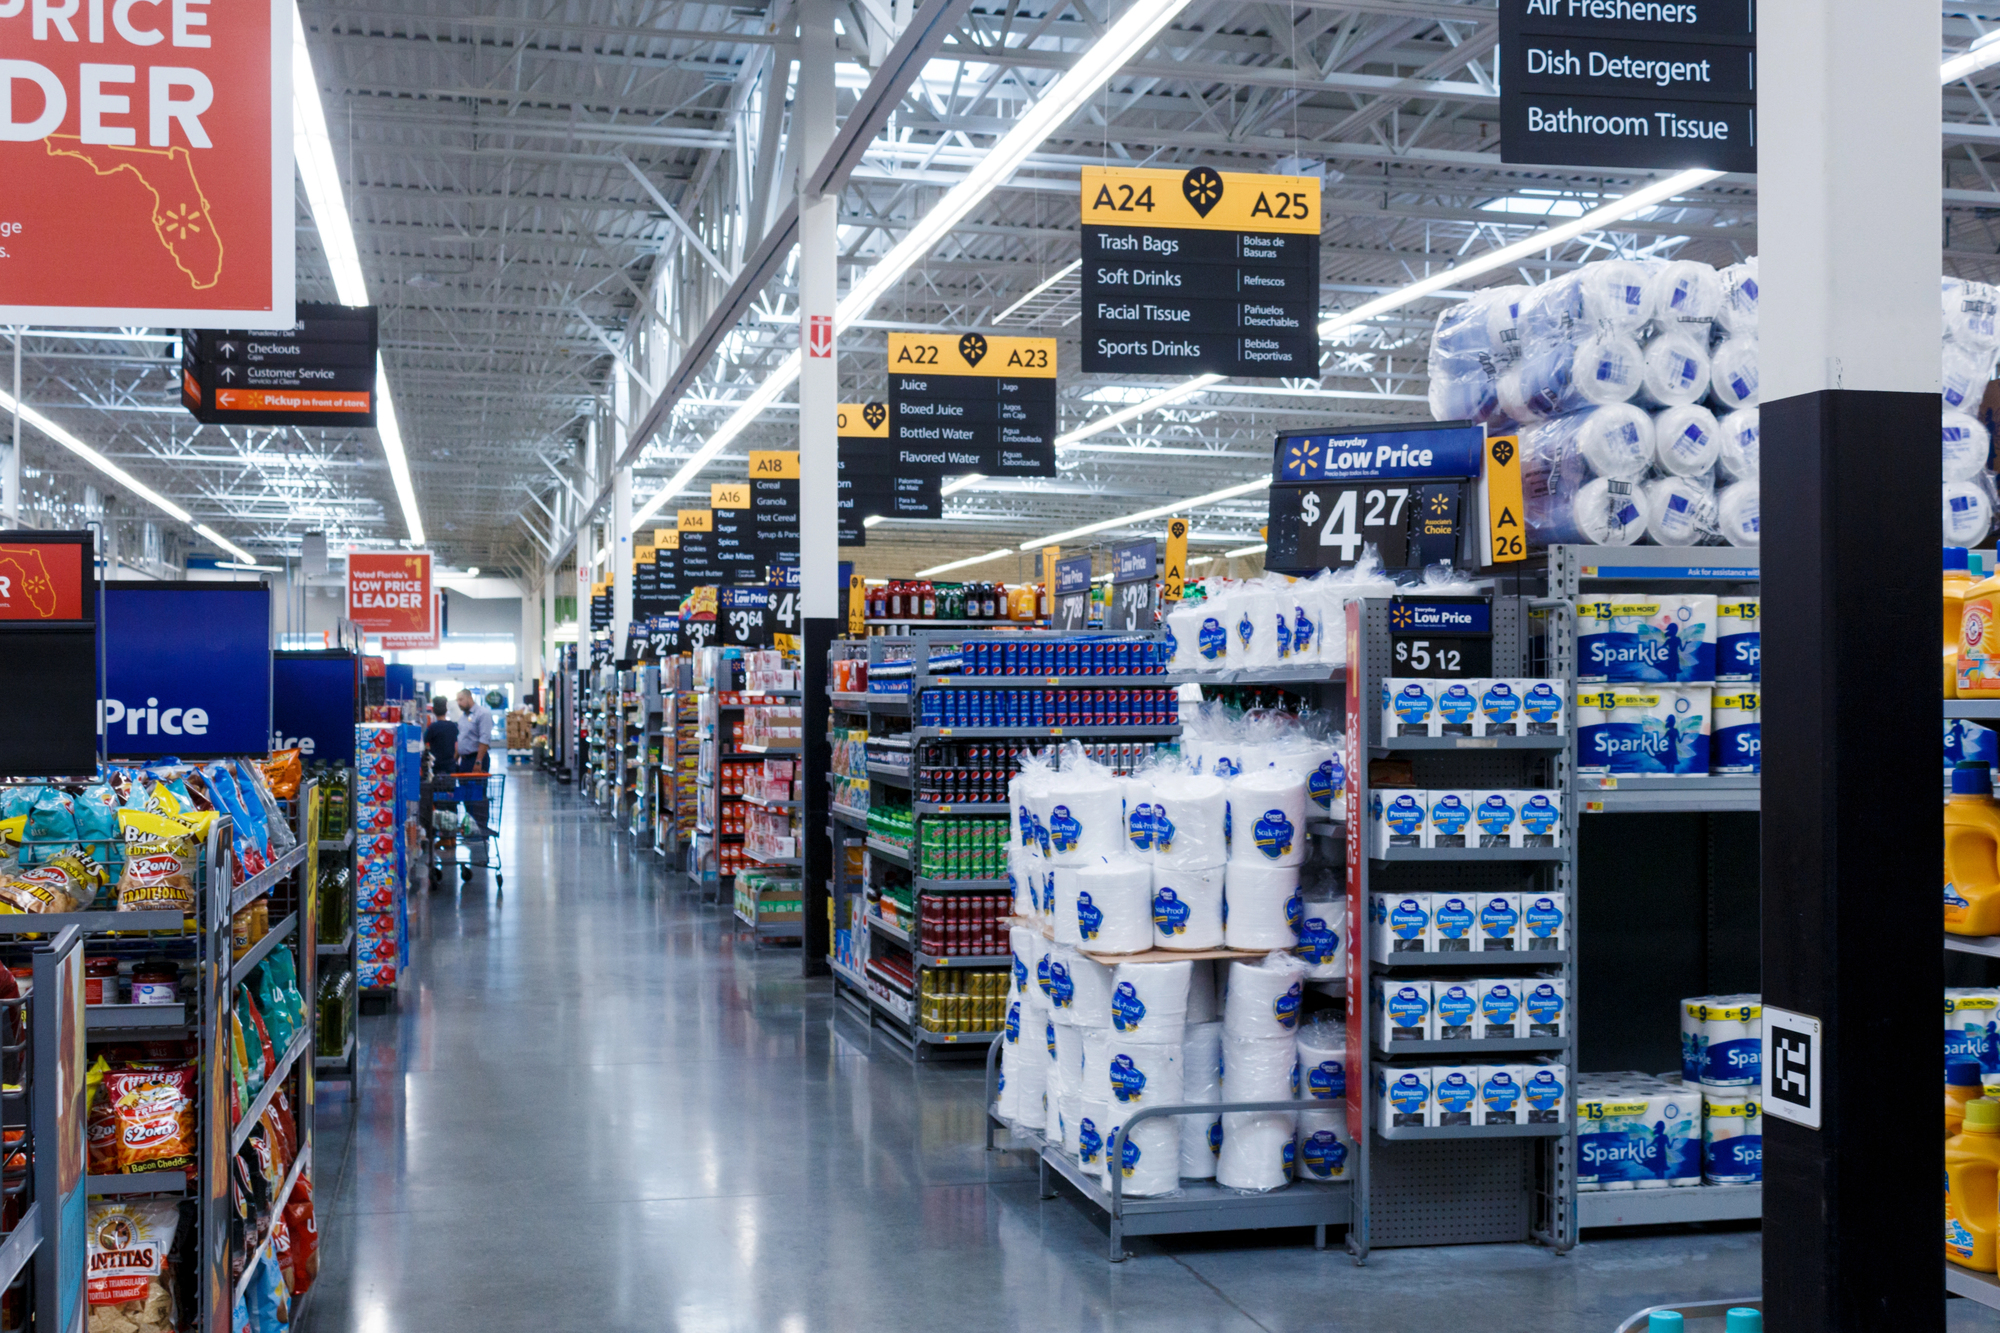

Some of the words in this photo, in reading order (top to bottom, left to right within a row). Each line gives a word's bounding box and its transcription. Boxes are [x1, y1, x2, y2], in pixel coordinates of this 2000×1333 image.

[1527, 0, 1557, 16] Air
[1569, 0, 1697, 23] Fresheners
[1528, 49, 1580, 75] Dish
[1589, 52, 1710, 86] Detergent
[1528, 107, 1648, 136] Bathroom
[1654, 112, 1728, 140] Tissue
[1093, 183, 1155, 212] A24
[1251, 192, 1309, 219] A25
[1098, 234, 1138, 250] Trash
[1143, 236, 1179, 255] Bags
[1243, 236, 1270, 247] Bolsas
[1273, 237, 1285, 247] de
[1243, 248, 1276, 258] Basuras
[1098, 268, 1128, 285] Soft
[1134, 270, 1181, 286] Drinks
[1244, 275, 1285, 286] Refrescos
[1098, 303, 1139, 320] Facial
[1143, 305, 1190, 322] Tissue
[1244, 305, 1284, 315] Pañuelos
[1244, 316, 1299, 327] Desechables
[248, 343, 300, 354] Checkouts
[1098, 339, 1148, 358] Sports
[1152, 340, 1200, 357] Drinks
[1245, 339, 1279, 349] Bebidas
[897, 345, 938, 364] A22
[1007, 349, 1048, 367] A23
[1245, 351, 1292, 362] Deportivas
[248, 367, 296, 378] Customer
[299, 369, 334, 379] Service
[900, 379, 927, 391] Juice
[264, 395, 300, 407] Pickup
[312, 398, 331, 406] front
[900, 404, 933, 414] Boxed
[936, 405, 963, 415] Juice
[1003, 404, 1021, 412] Jugos
[1013, 412, 1026, 420] Caja
[900, 427, 939, 439] Bottled
[942, 428, 974, 440] Water
[1328, 437, 1368, 448] Everyday
[900, 451, 945, 463] Flavored
[948, 453, 980, 464] Water
[1003, 451, 1022, 459] Aguas
[1325, 448, 1372, 469] Low
[1375, 444, 1433, 468] Price
[757, 459, 782, 472] A18
[757, 481, 780, 490] Cereal
[719, 492, 740, 503] A16
[757, 498, 787, 506] Granola
[684, 517, 703, 526] A14
[757, 514, 771, 522] Hot
[773, 514, 796, 522] Cereal
[1497, 507, 1517, 528] A
[718, 524, 737, 534] Sugar
[1424, 526, 1452, 534] Choice
[684, 533, 702, 541] Candy
[757, 531, 775, 540] Syrup
[718, 538, 739, 547] Spices
[1496, 535, 1522, 556] 26
[405, 558, 422, 578] #1
[1121, 557, 1132, 573] Low
[1133, 555, 1146, 571] Price
[353, 571, 376, 579] Voted
[377, 571, 408, 580] Florida's
[1062, 571, 1072, 585] Low
[1072, 570, 1083, 584] Price
[1168, 566, 1180, 579] A
[352, 580, 380, 592] LOW
[384, 581, 422, 592] PRICE
[1165, 584, 1181, 596] 24
[352, 594, 422, 608] LEADER
[735, 594, 748, 603] Low
[750, 594, 767, 604] Price
[1594, 603, 1612, 619] 13
[1738, 604, 1756, 619] 13
[1414, 612, 1439, 623] Low
[1442, 612, 1472, 624] Price
[1591, 642, 1669, 666] Sparkle
[1598, 693, 1616, 709] 13
[1739, 694, 1756, 709] 13
[97, 697, 209, 735] Price
[1594, 732, 1669, 756] Sparkle
[123, 886, 189, 904] TRADITIONAL
[1740, 1007, 1751, 1021] 9
[1530, 1086, 1558, 1094] Premium
[1586, 1103, 1603, 1119] 13
[1745, 1103, 1757, 1118] 9
[1583, 1140, 1657, 1166] Sparkle
[131, 1162, 156, 1173] Bacon
[109, 1277, 147, 1287] TRIANGULARES
[89, 1292, 111, 1300] TORTILLA
[113, 1289, 140, 1298] TRIANGLES
